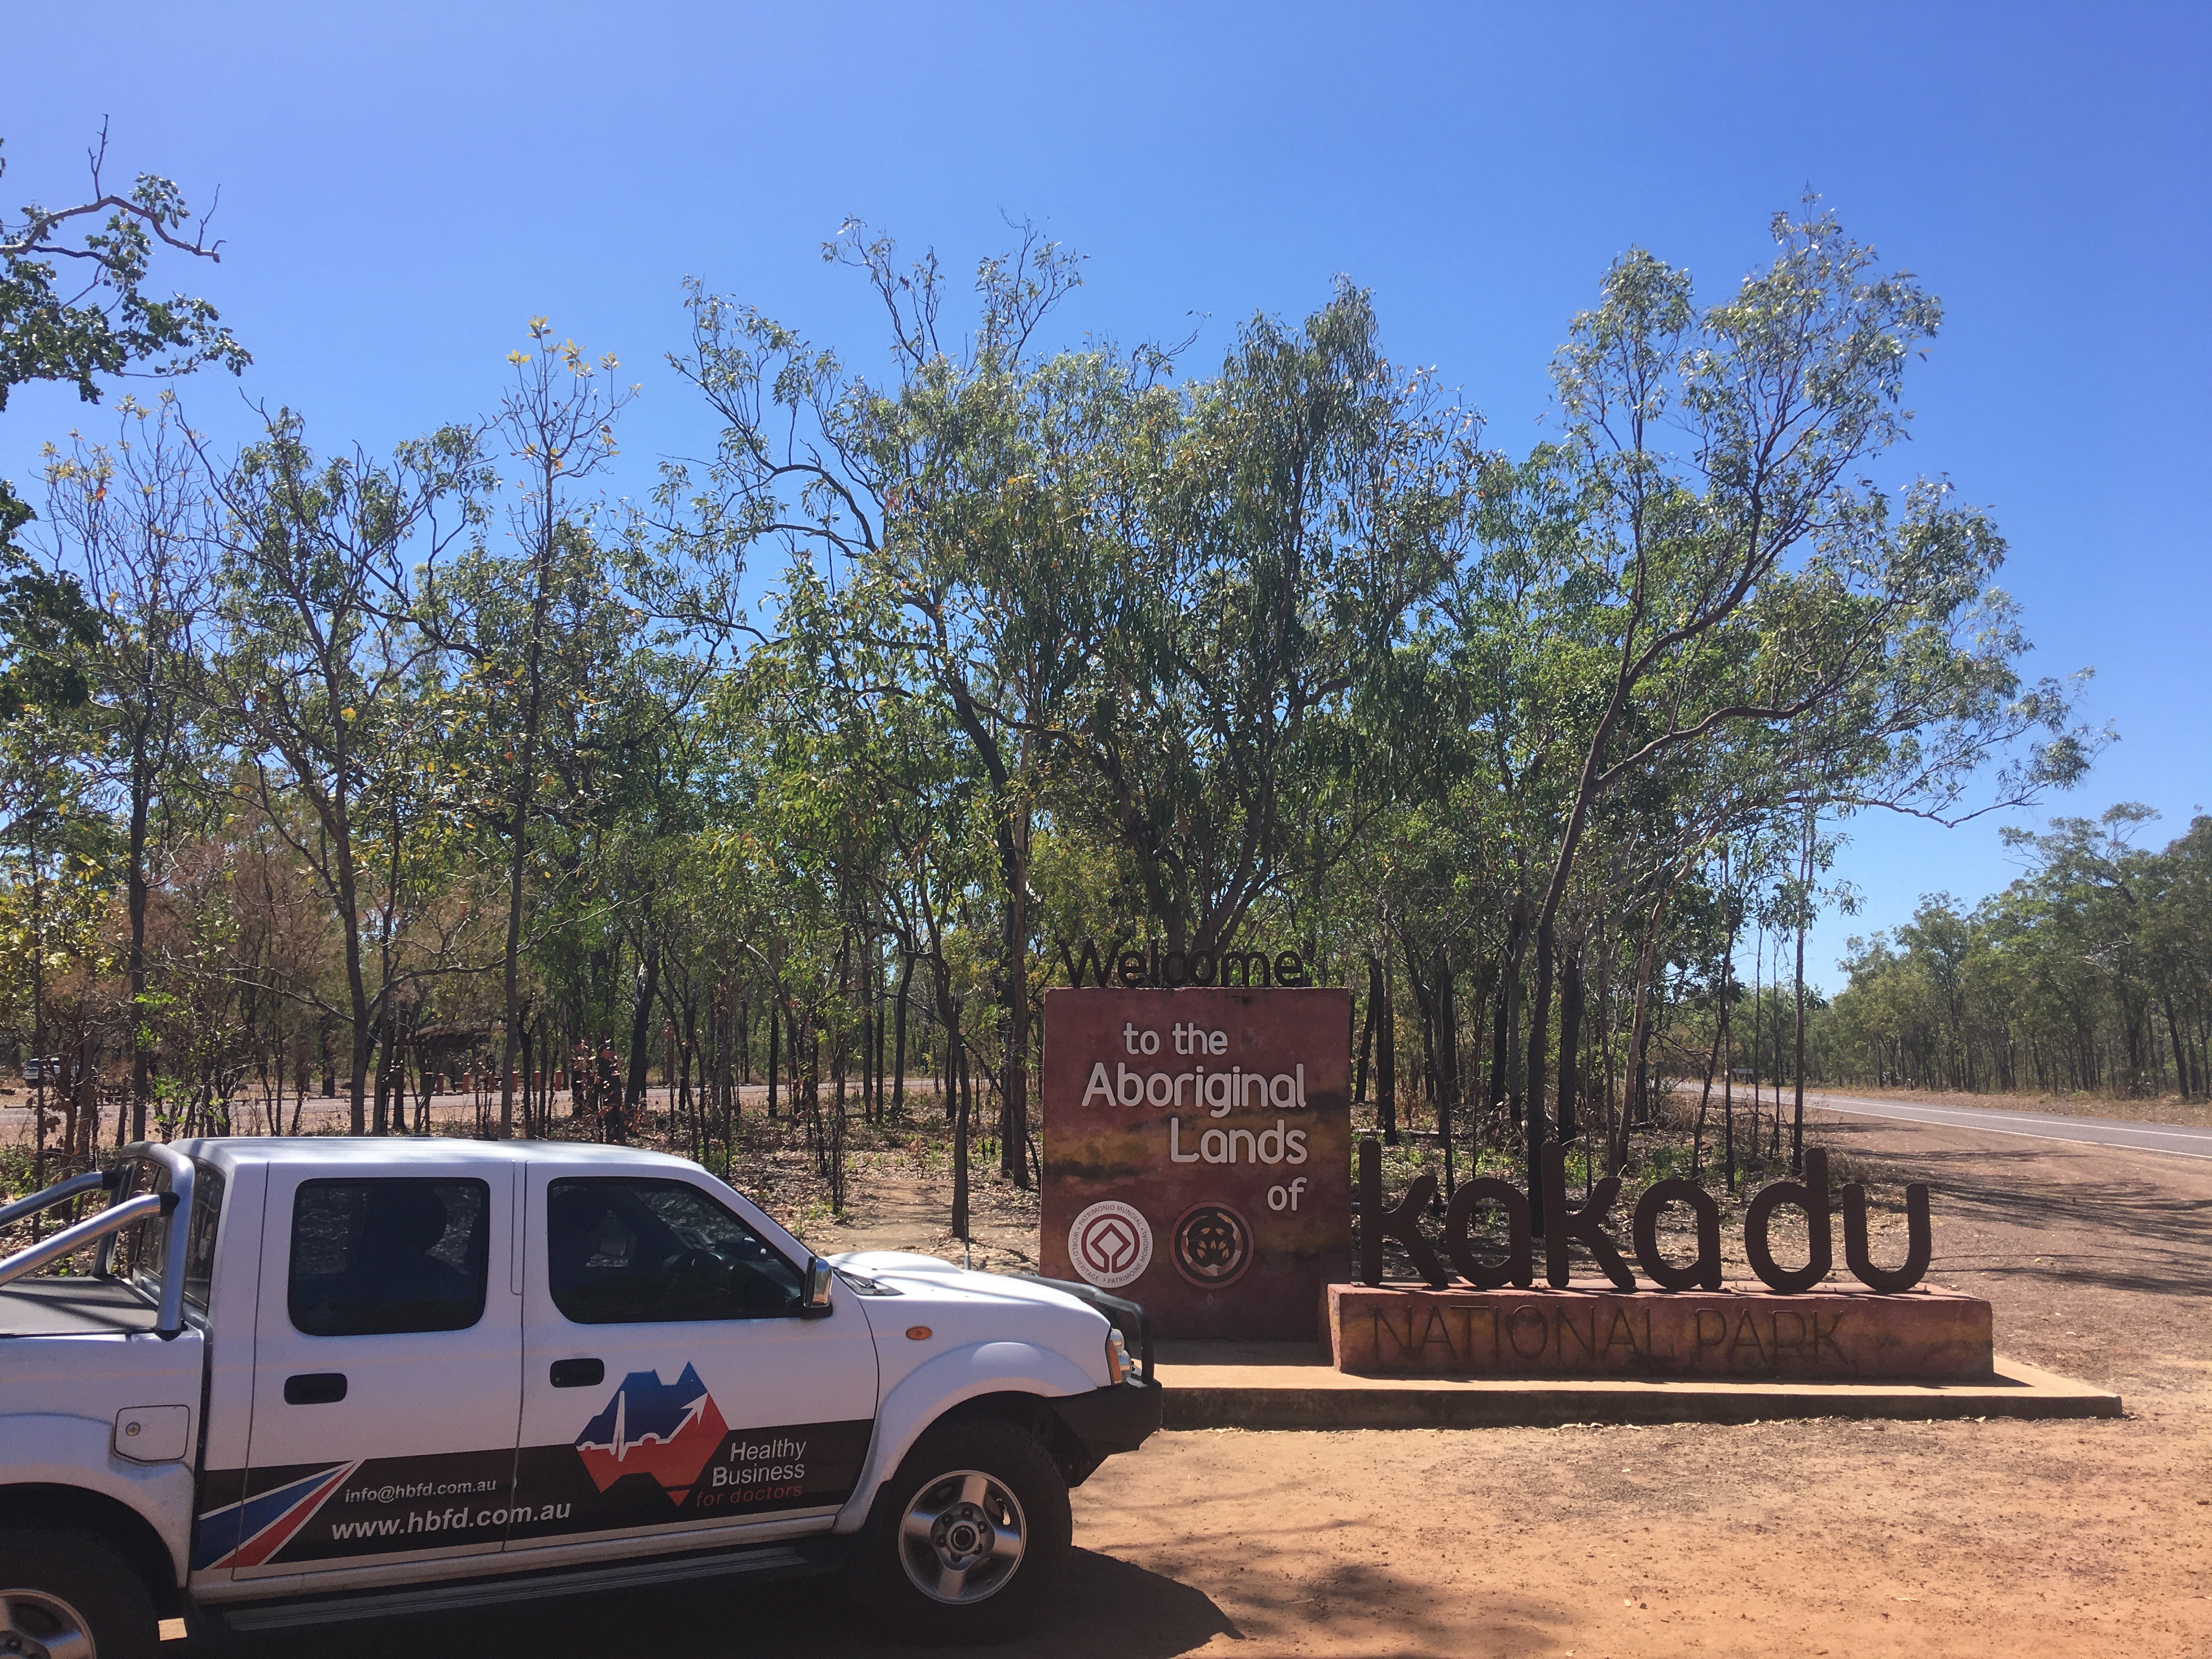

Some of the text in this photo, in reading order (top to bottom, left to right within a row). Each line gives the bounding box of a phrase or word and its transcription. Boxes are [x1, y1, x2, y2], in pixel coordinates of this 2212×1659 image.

[1057, 939, 1303, 987] Welcome
[1124, 1023, 1228, 1056] to the
[1082, 1062, 1307, 1118] Aboriginal
[1171, 1118, 1308, 1164] Lands
[1267, 1177, 1308, 1211] of
[1079, 1204, 1143, 1227] PATRIMONIO MUNDIAL
[1358, 1140, 1932, 1292] kakadu
[1075, 1257, 1099, 1282] HERITAGE
[1108, 1229, 1149, 1284] PATRIMOINE MONDIAL
[1372, 1305, 1852, 1366] NATIONAL PARK
[730, 1438, 807, 1463] Healthy
[345, 1479, 496, 1503] info@hbfd.com.au
[713, 1463, 805, 1487] Business
[697, 1485, 803, 1508] for doctors
[331, 1502, 572, 1541] www.hbfd.com.au
